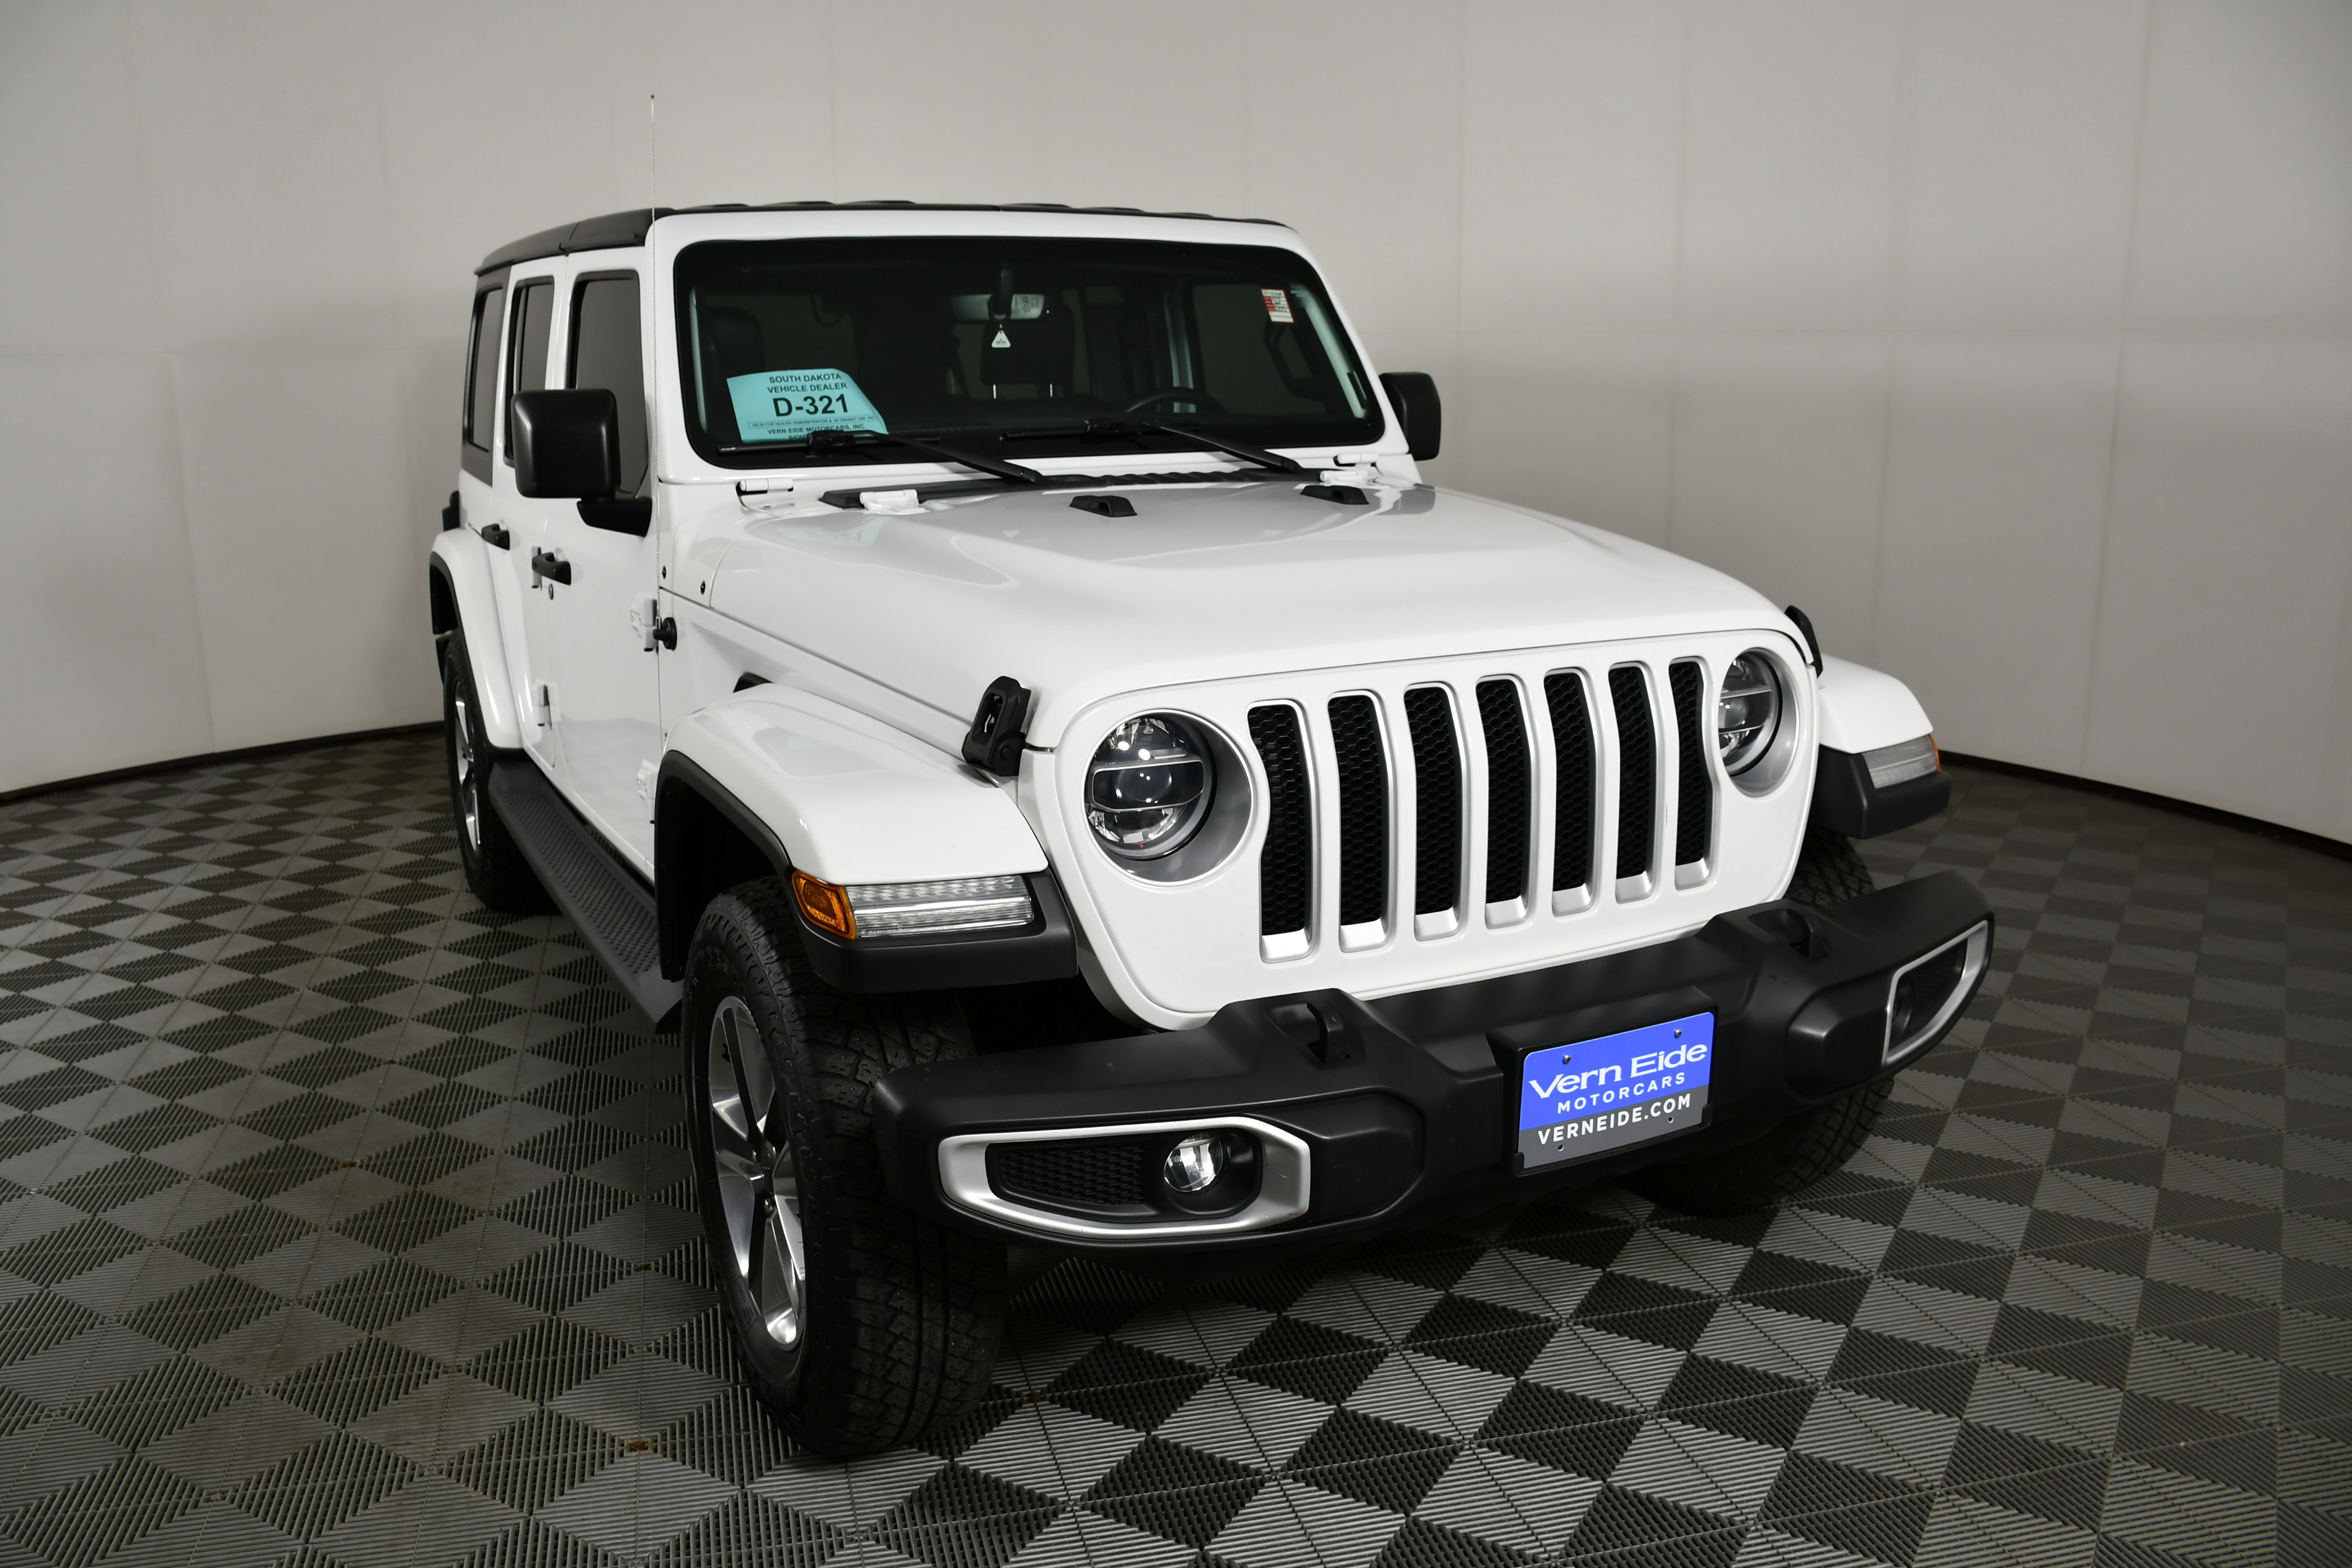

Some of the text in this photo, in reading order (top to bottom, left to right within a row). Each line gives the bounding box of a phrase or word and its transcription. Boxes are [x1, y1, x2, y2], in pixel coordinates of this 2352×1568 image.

[767, 382, 848, 393] VEHICLE DEALER
[803, 373, 842, 382] DAKOTA
[773, 394, 848, 417] D-321
[1529, 1044, 1708, 1099] Vern Eide
[1557, 1072, 1685, 1114] MOTORCARS
[1538, 1093, 1691, 1145] VERNEIDE.COM
